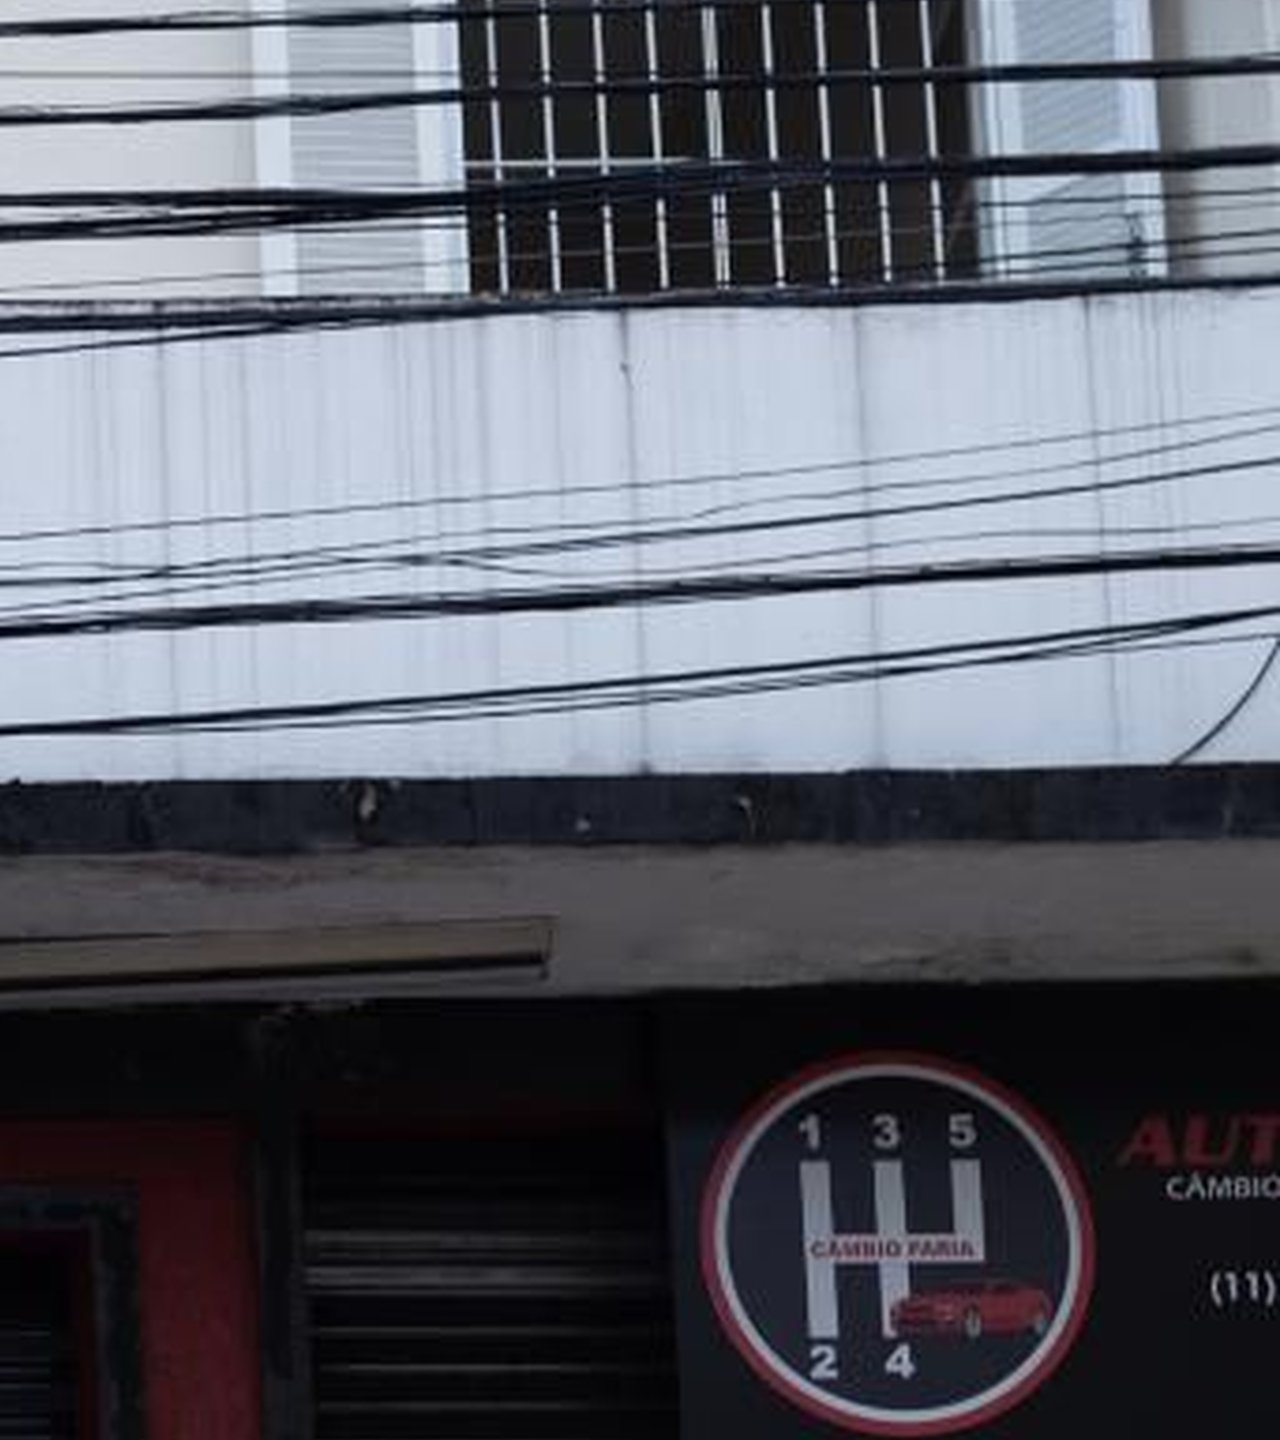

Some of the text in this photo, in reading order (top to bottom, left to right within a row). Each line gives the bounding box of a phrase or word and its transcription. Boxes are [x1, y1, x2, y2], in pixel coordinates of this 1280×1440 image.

[798, 1114, 977, 1149] 1 3 5
[1210, 1269, 1278, 1307] (11)
[810, 1345, 915, 1379] 2 4
